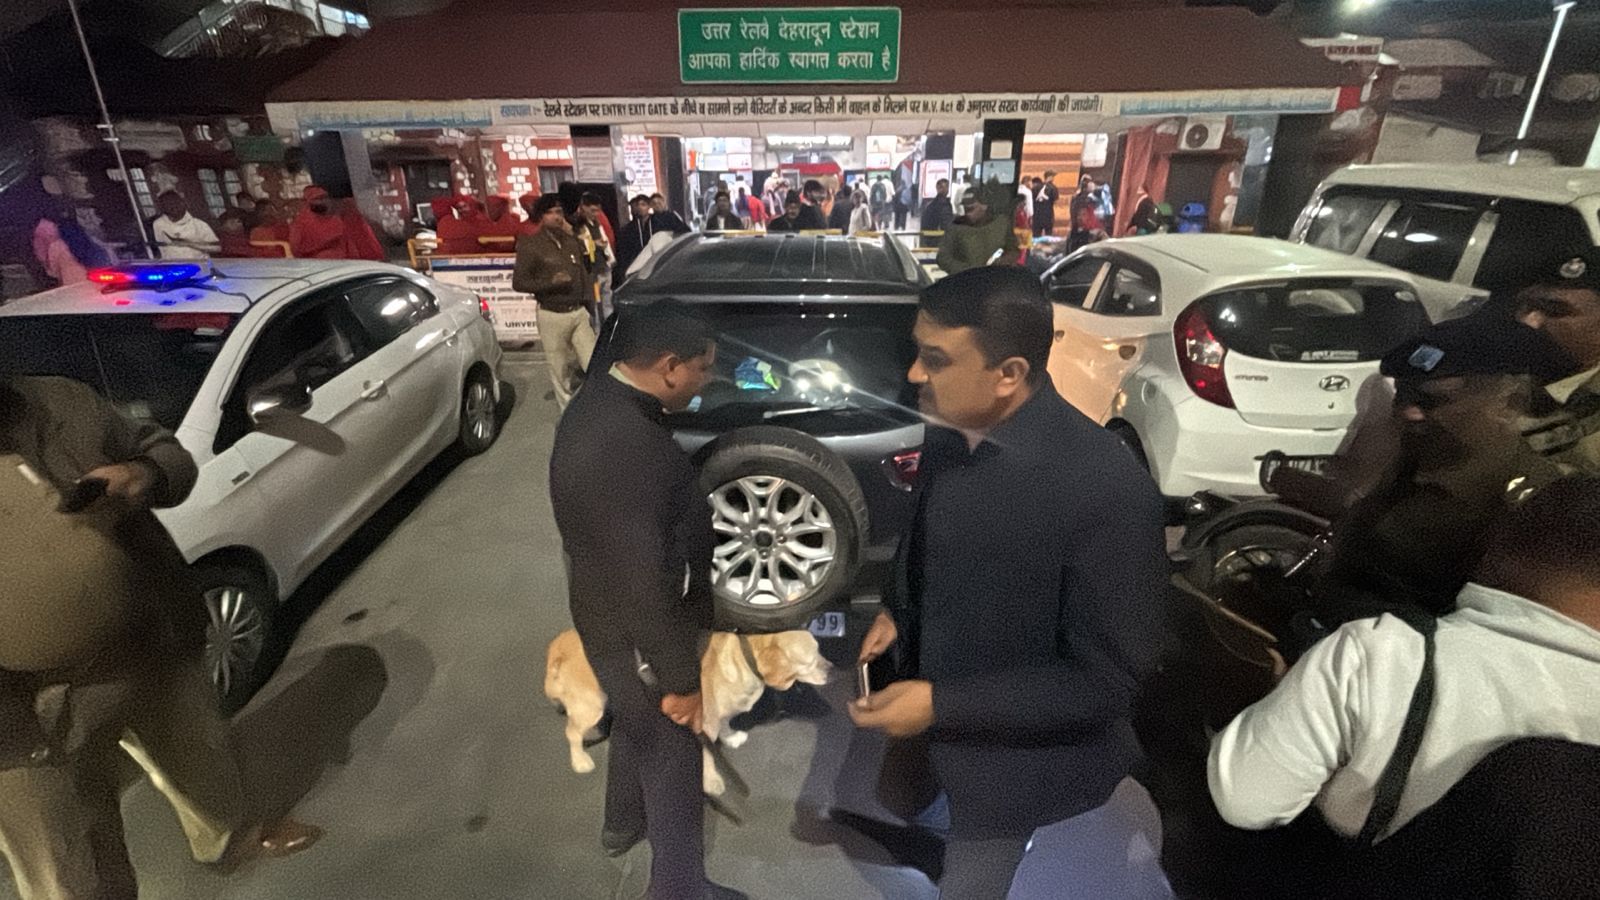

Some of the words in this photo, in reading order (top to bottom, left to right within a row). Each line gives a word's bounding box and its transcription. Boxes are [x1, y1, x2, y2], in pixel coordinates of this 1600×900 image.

[702, 22, 731, 40] उत्तर
[740, 17, 769, 39] रेलवे
[778, 17, 831, 46] देहरादून
[839, 17, 880, 39] स्टेशन
[687, 53, 731, 70] आपका
[739, 47, 780, 70] हार्दिक
[789, 52, 829, 69] स्वागत
[837, 52, 873, 69] करता
[881, 45, 891, 71] है
[544, 99, 562, 117] रेलवे
[564, 99, 587, 117] स्टेशन
[590, 104, 600, 116] पर
[602, 104, 626, 116] ENTRY
[630, 103, 646, 116] EXIT
[648, 103, 668, 115] GATE
[670, 99, 679, 115] के
[708, 98, 731, 115] सामने
[778, 99, 787, 114] के
[814, 97, 835, 114] किसी
[837, 97, 847, 114] भी
[850, 101, 871, 115] वाहन
[872, 97, 881, 114] के
[884, 95, 908, 114] मिलने
[910, 101, 921, 114] पर
[922, 101, 938, 113] M.V.
[941, 101, 953, 113] Act
[956, 95, 965, 113] के
[967, 100, 996, 119] अनुसार
[1058, 95, 1069, 112] की
